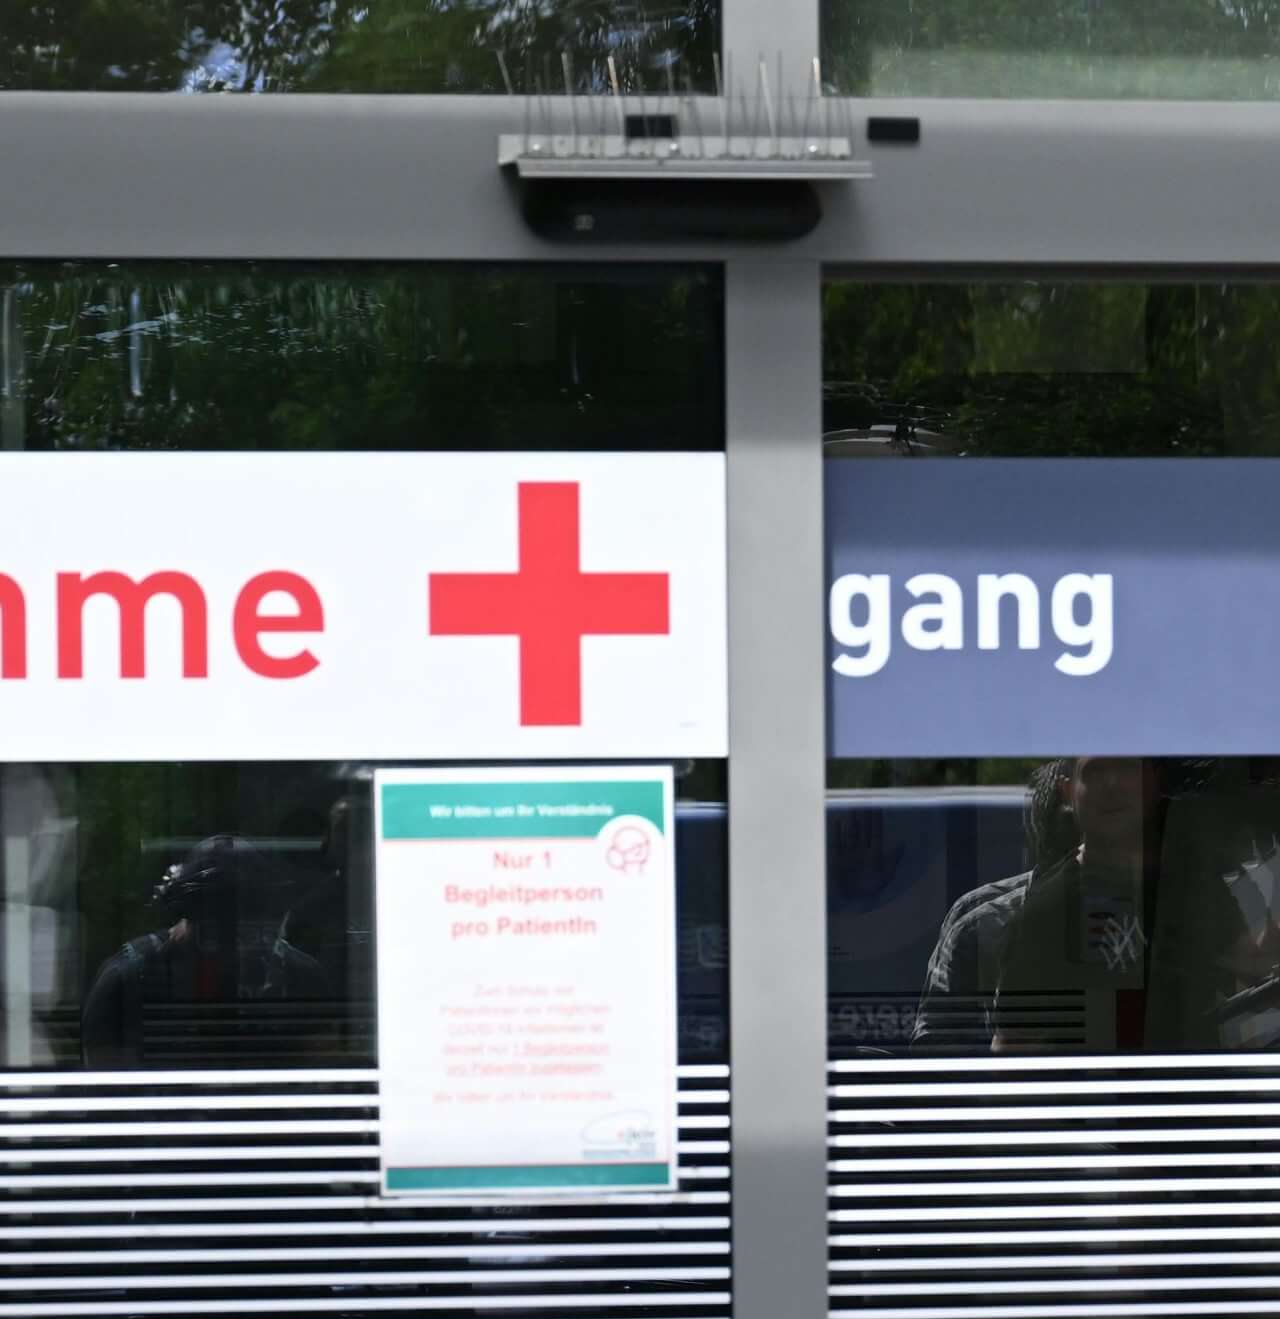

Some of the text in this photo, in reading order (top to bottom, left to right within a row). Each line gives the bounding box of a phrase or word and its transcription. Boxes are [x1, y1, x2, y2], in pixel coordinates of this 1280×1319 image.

[830, 570, 1114, 677] gang
[429, 804, 453, 818] Wir
[494, 805, 516, 818] um
[493, 851, 553, 869] Nur 1
[444, 883, 604, 907] Begleitperson
[450, 920, 489, 939] pro
